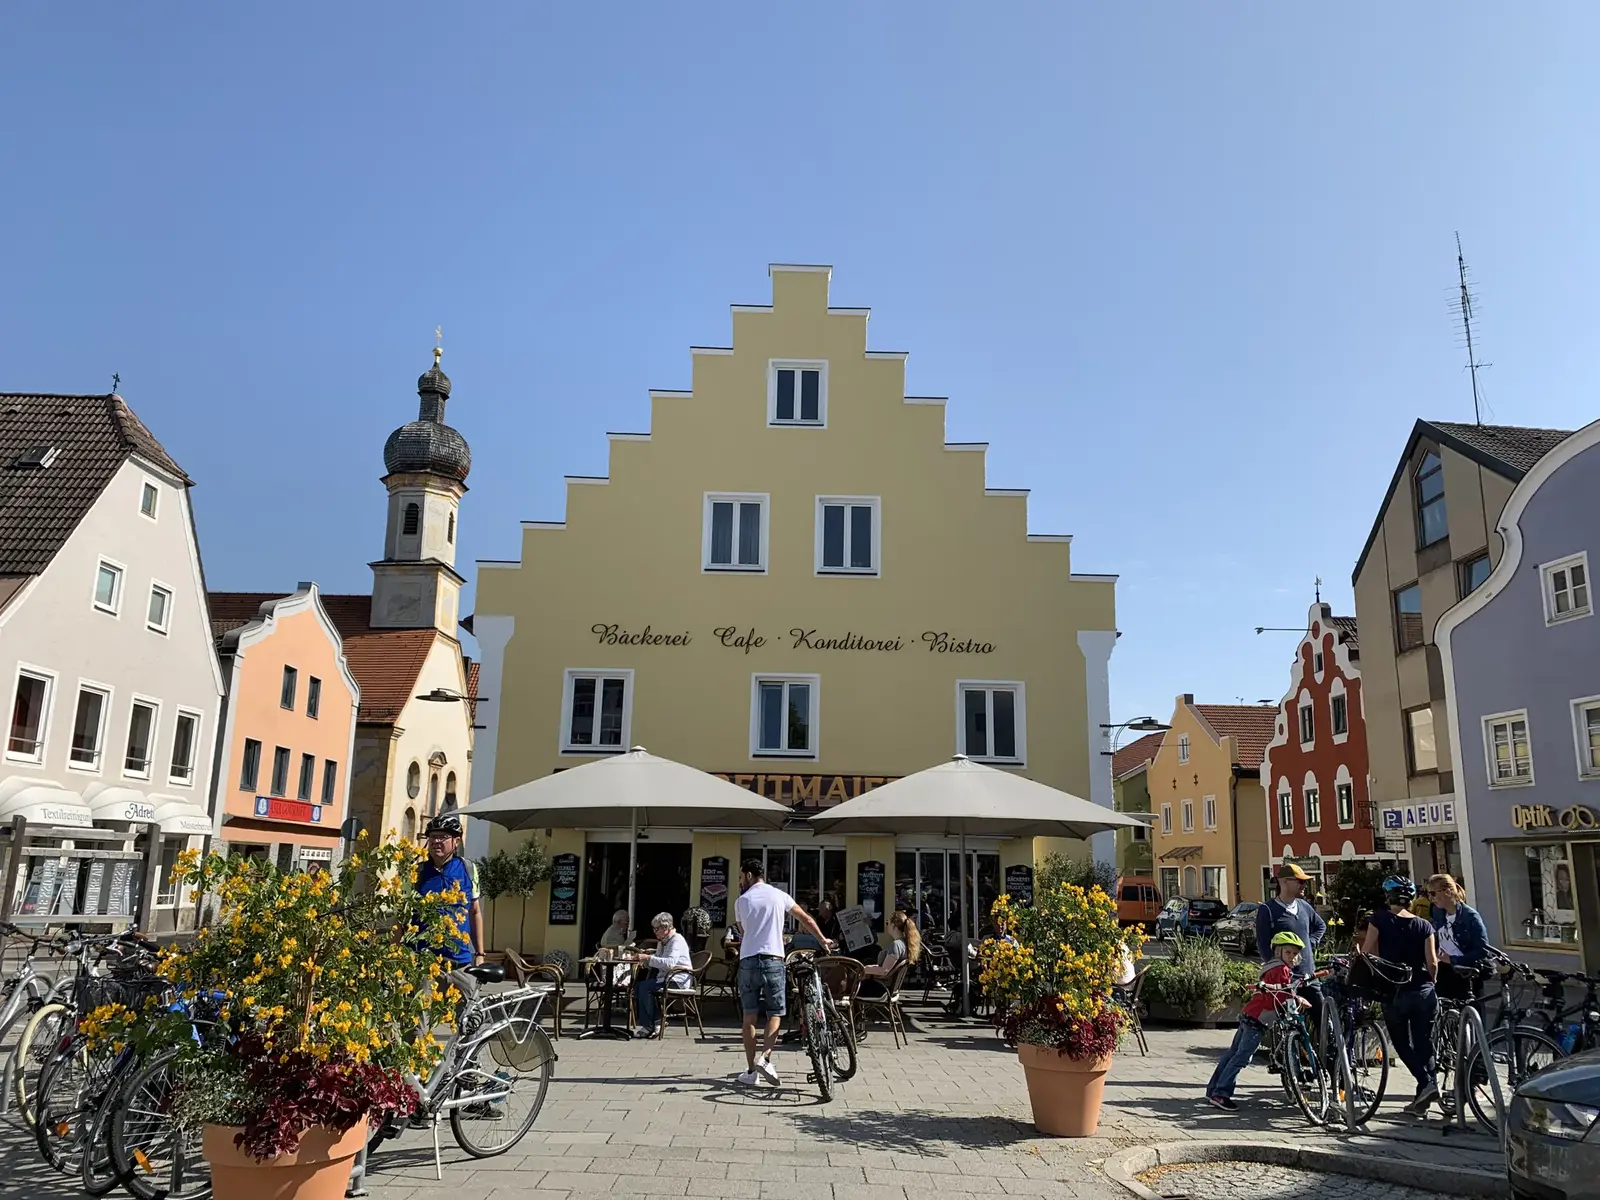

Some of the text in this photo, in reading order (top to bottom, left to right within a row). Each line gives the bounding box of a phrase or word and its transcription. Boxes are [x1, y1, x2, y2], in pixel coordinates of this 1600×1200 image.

[713, 626, 768, 655] Cafe
[789, 628, 904, 651] Konditorei
[921, 631, 996, 654] Bistro
[1386, 812, 1397, 827] P
